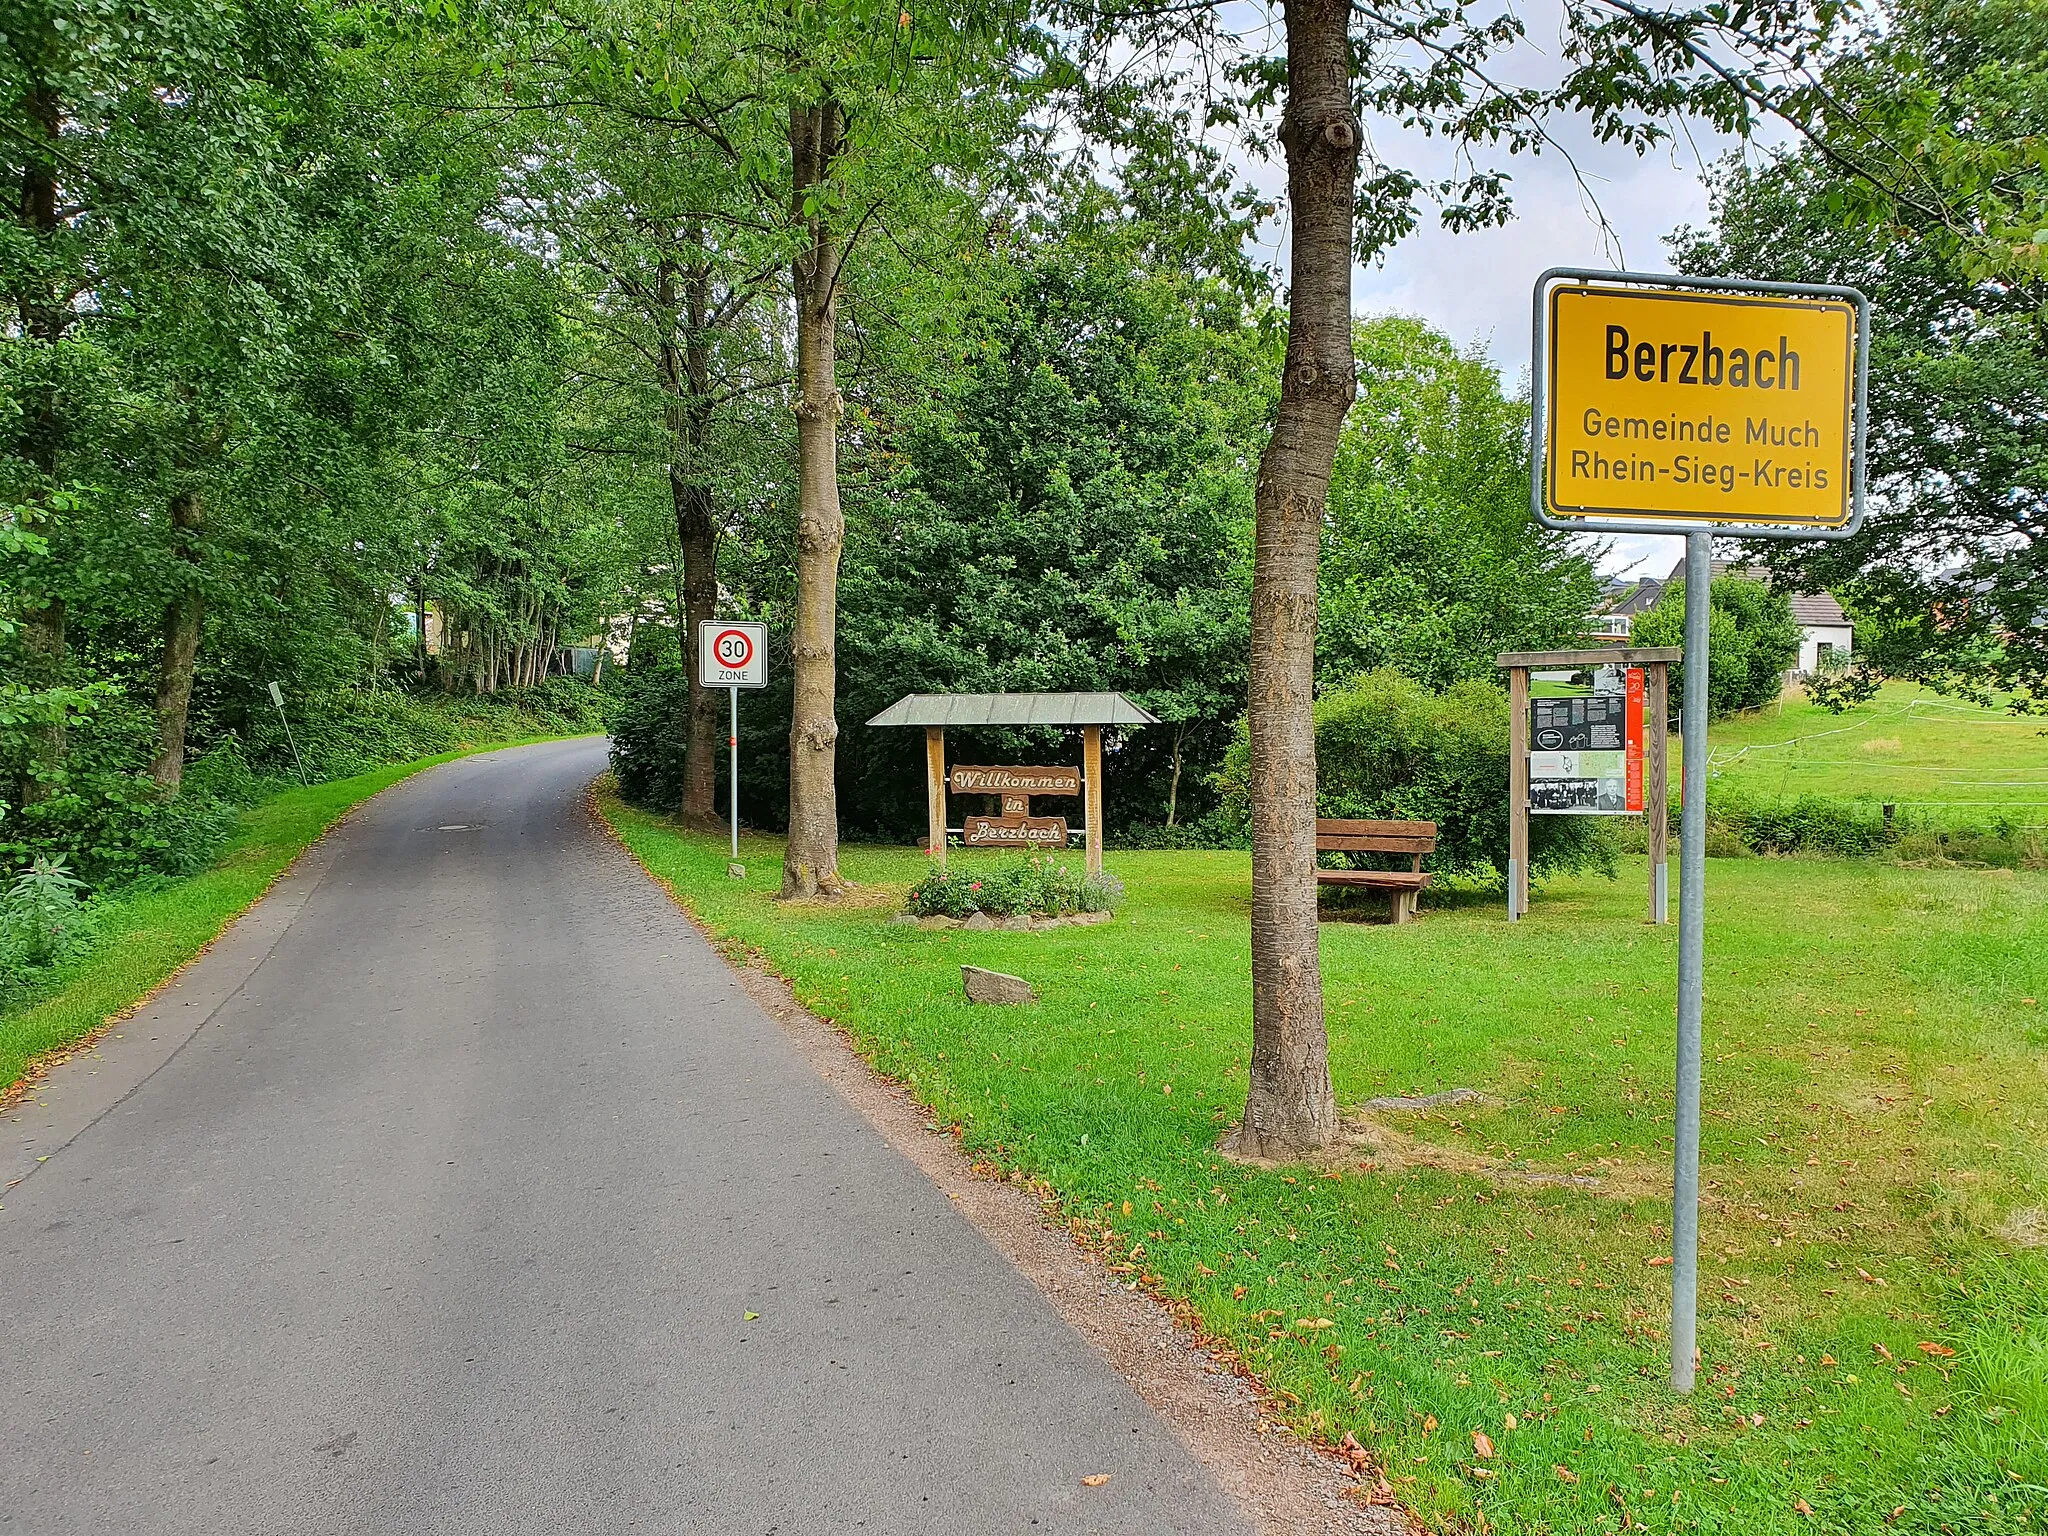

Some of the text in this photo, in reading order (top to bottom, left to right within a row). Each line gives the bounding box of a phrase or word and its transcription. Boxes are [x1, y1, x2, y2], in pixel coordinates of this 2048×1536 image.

[1605, 324, 1800, 391] Berzbach
[1583, 408, 1820, 448] Gemeinde Much
[1571, 449, 1829, 493] Rhein-Sieg-Kreis
[720, 640, 746, 658] 30
[718, 669, 749, 681] ZONE
[953, 770, 1077, 790] Willkommen
[1004, 797, 1024, 812] in
[970, 821, 1062, 842] Berzbach
